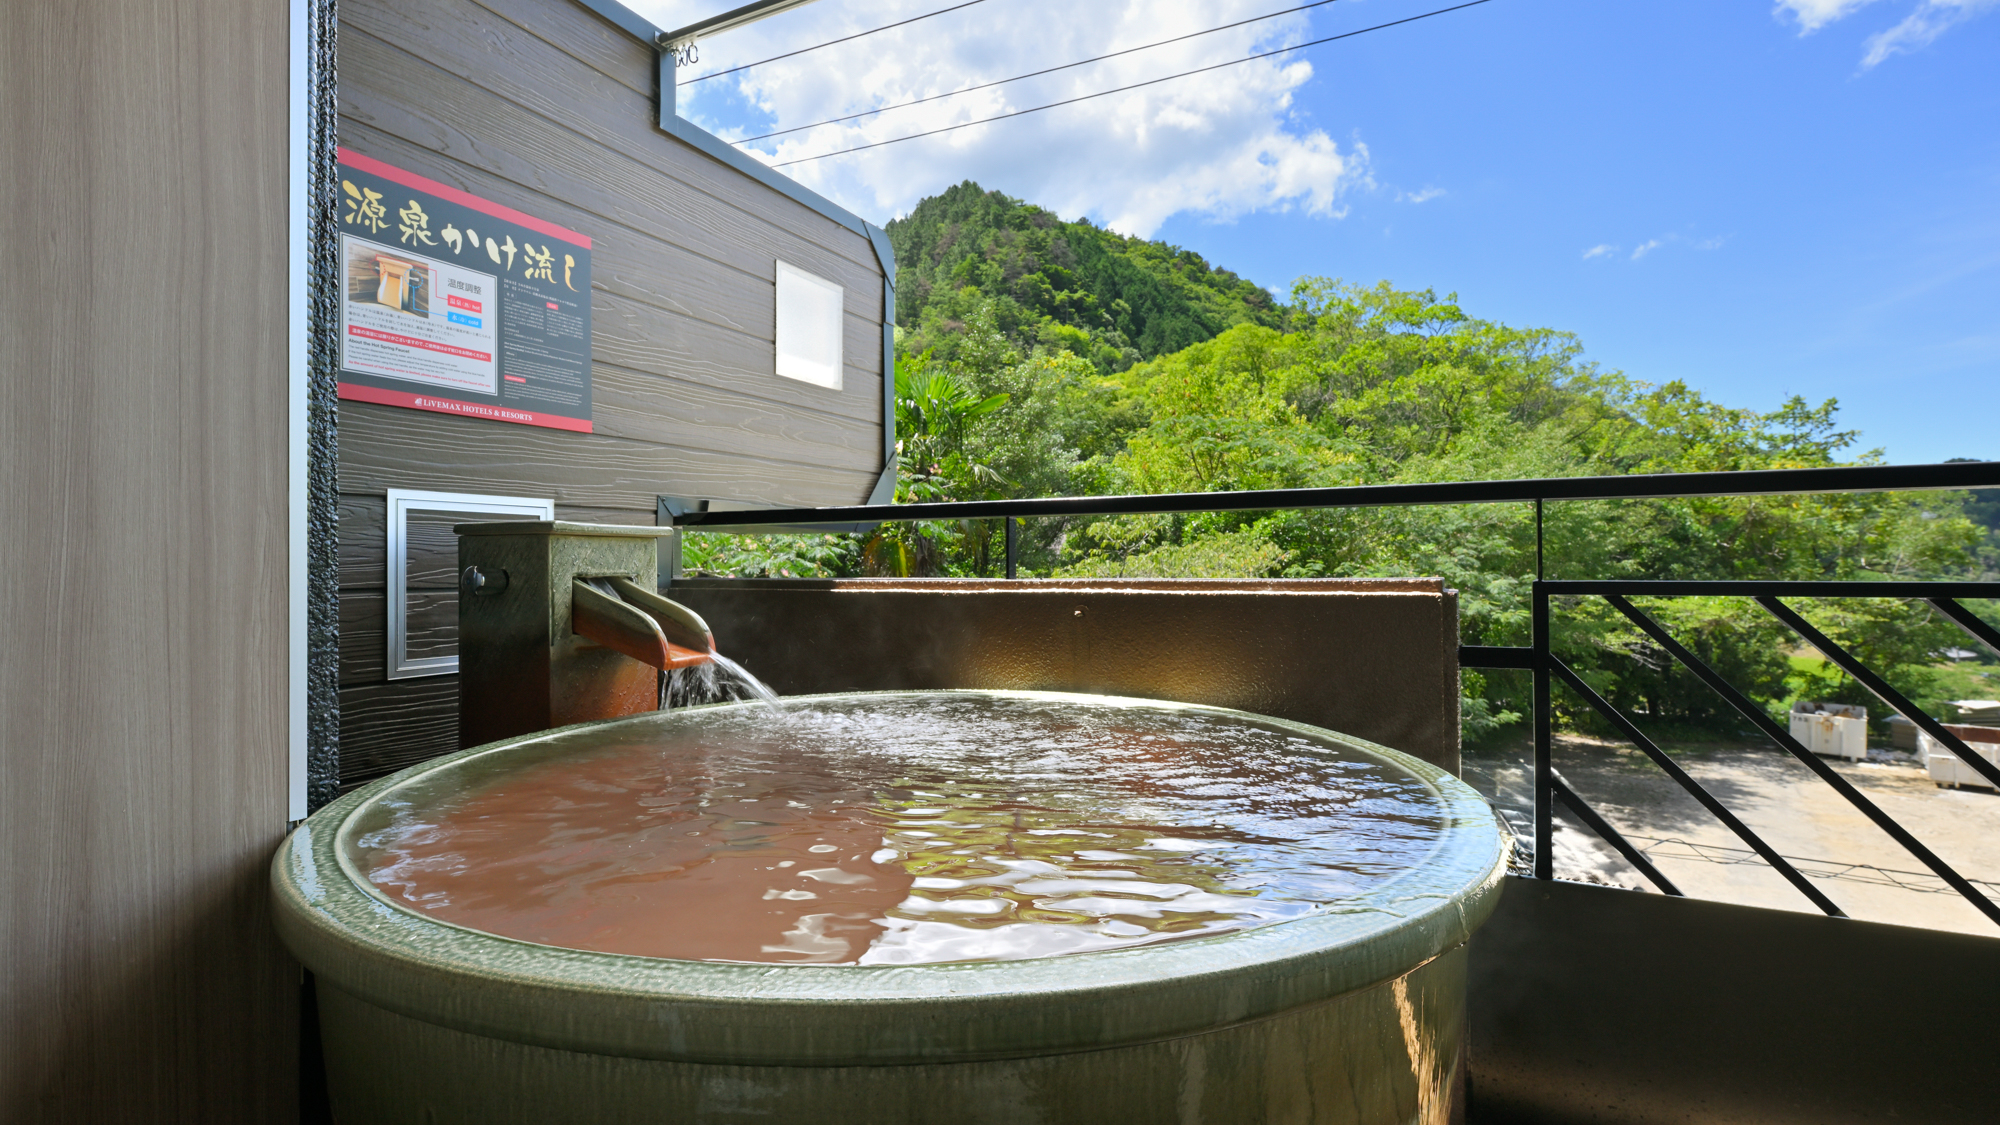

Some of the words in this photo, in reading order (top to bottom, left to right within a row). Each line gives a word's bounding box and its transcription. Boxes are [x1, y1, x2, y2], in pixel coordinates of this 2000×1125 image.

[342, 180, 580, 292] 源泉かけ流し
[448, 278, 482, 295] 温度調整
[424, 399, 461, 411] LiVEMAX
[462, 405, 492, 416] HOTELS
[501, 410, 532, 421] RESORTS
